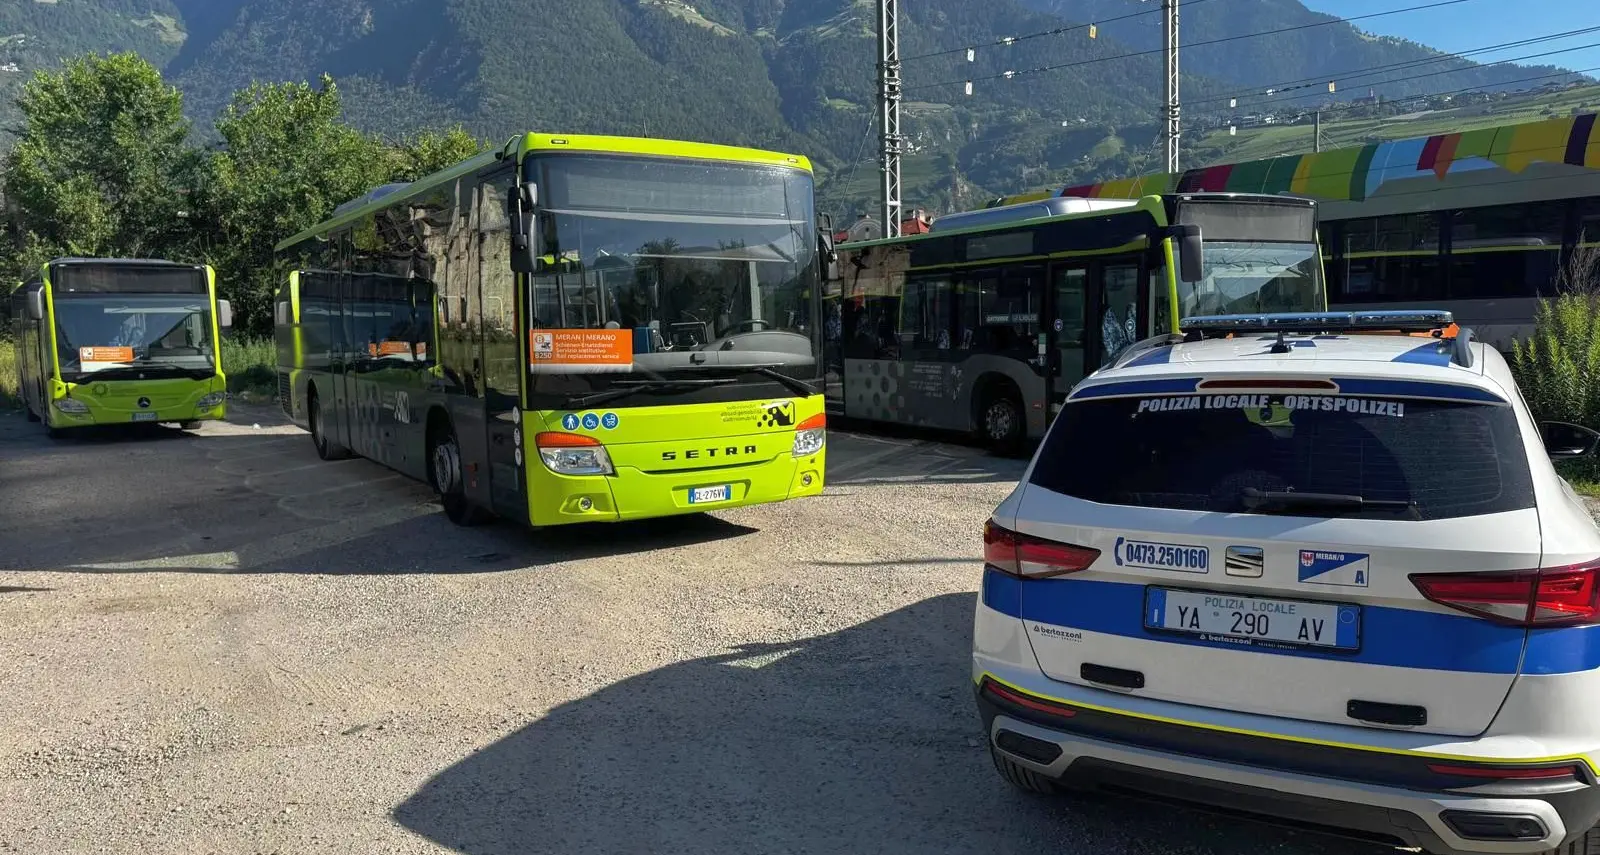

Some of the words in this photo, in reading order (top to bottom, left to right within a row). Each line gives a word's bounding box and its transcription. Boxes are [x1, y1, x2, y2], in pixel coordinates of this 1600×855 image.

[556, 333, 581, 341] MERAN
[586, 333, 617, 341] MERANO
[1138, 396, 1201, 413] POLIZIA
[1204, 395, 1270, 409] LOCALE
[1284, 395, 1404, 417] ORTSPOLIZEI
[662, 445, 756, 461] SETRA
[1126, 543, 1207, 569] 0473.250160
[1315, 552, 1345, 561] MERAN/O
[1354, 570, 1365, 584] A
[1204, 596, 1245, 610] POLIZIA
[1252, 600, 1297, 615] LOCALE
[1178, 605, 1200, 629] YA
[1230, 611, 1270, 636] 290
[1297, 617, 1325, 642] AV
[1041, 625, 1083, 639] bertazzoni
[1208, 634, 1252, 646] bertazzoni
